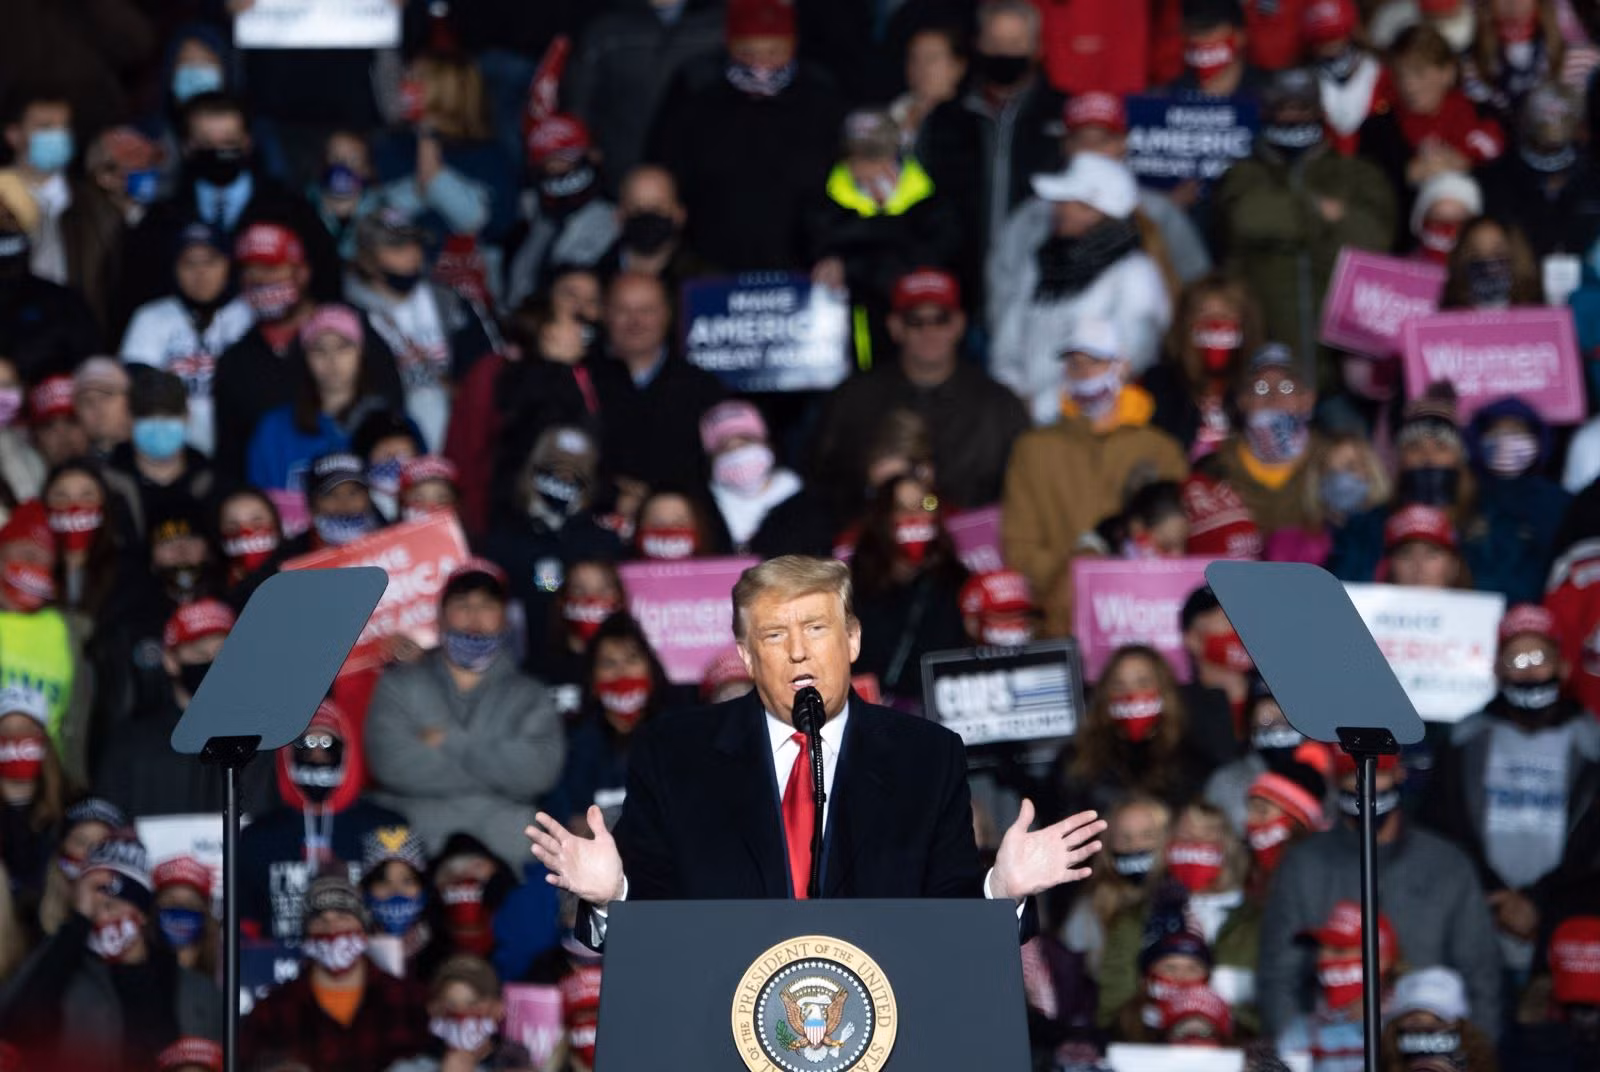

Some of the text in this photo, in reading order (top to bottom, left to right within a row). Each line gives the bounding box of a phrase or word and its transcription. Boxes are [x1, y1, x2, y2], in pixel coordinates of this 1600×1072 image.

[1126, 127, 1252, 157] AMERIC
[688, 314, 818, 346] AMERIC
[1421, 341, 1560, 382] Women
[738, 942, 892, 1072] OF THE PRESIDENT OF THE UNITED STA
